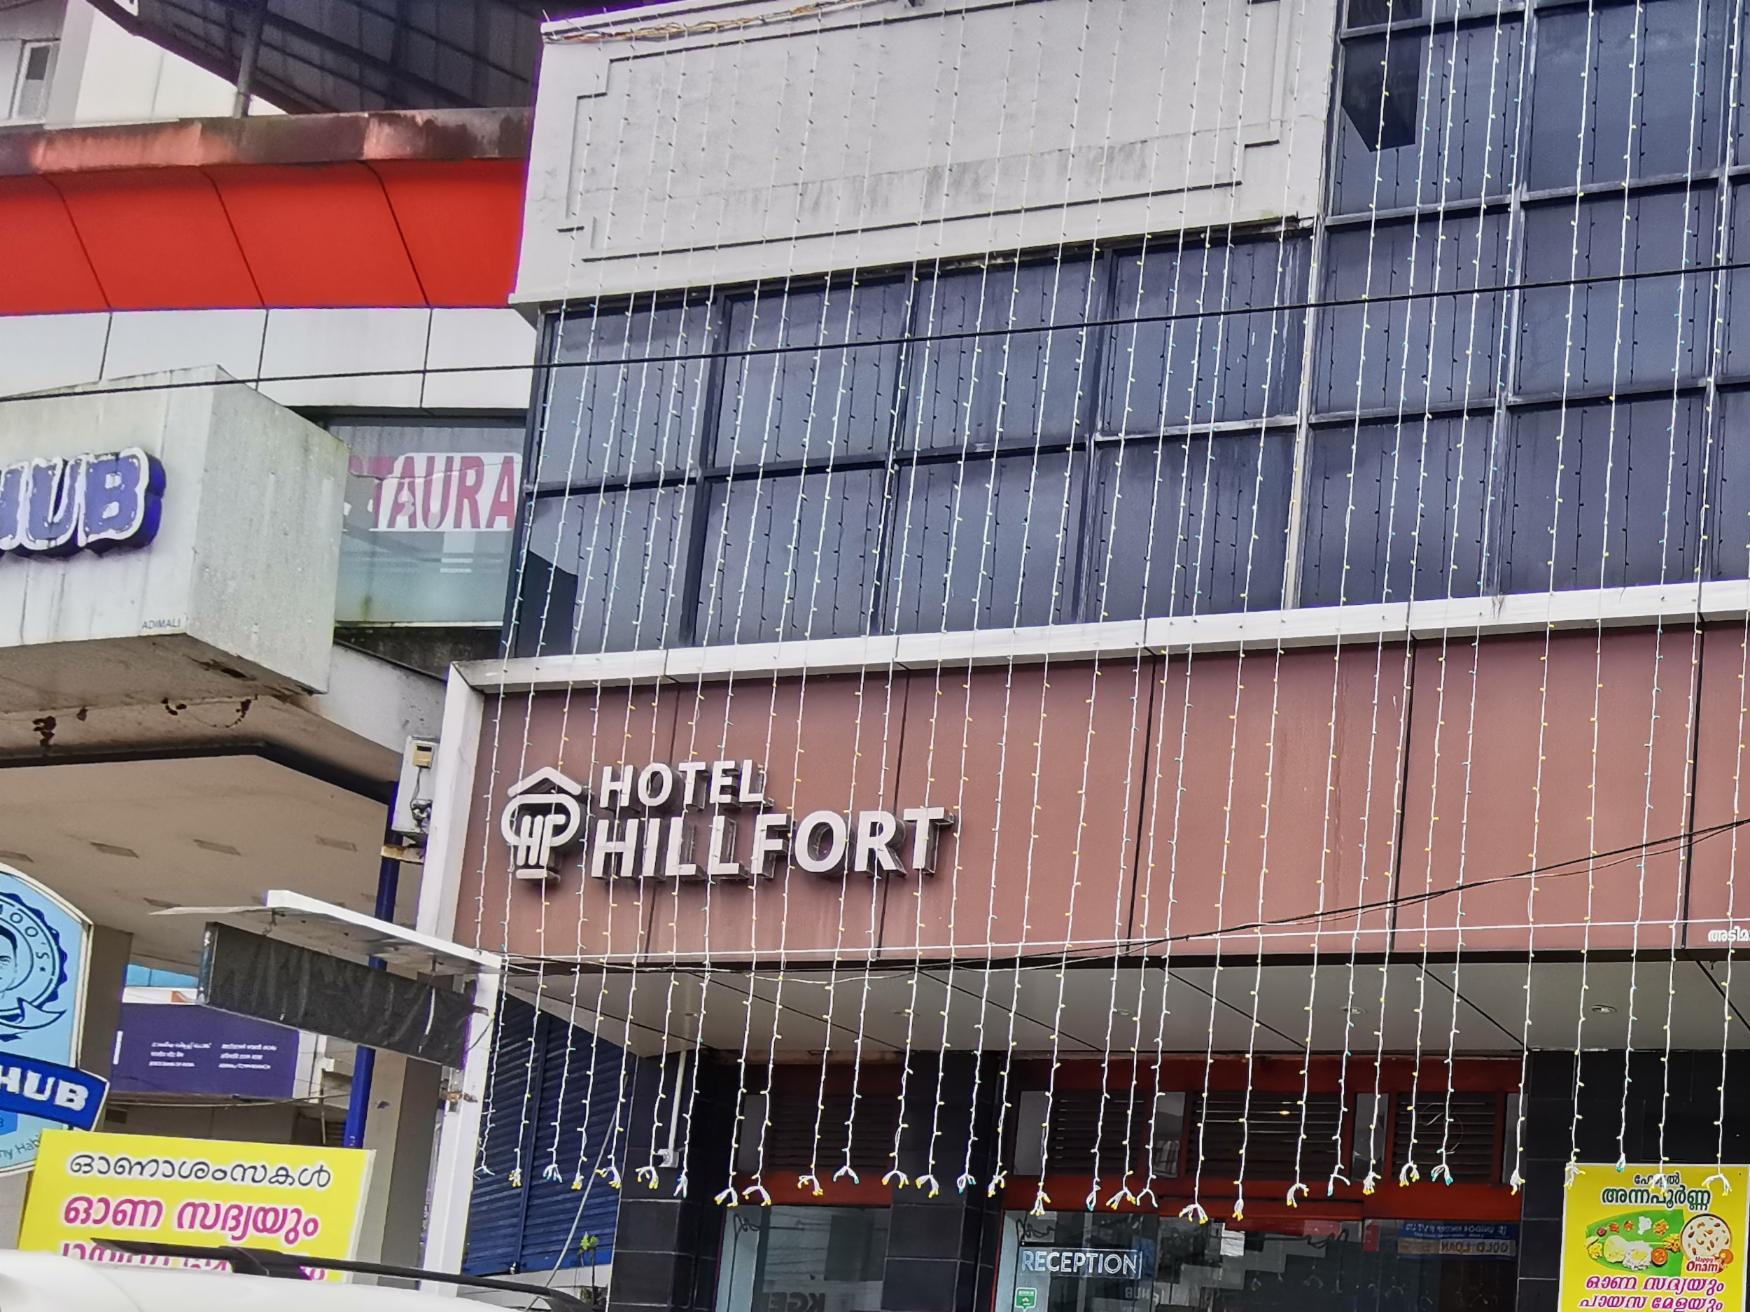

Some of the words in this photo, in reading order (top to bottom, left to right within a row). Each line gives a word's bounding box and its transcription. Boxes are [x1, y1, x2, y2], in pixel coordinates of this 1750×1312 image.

[600, 760, 770, 808] HOTEL
[592, 806, 956, 878] HILLFORT
[0, 1065, 89, 1111] HUB
[69, 1153, 332, 1188] ഓണാശംസകൾ
[63, 1195, 164, 1228] ഓണ
[176, 1200, 320, 1245] സദ്യയും
[1021, 1250, 1137, 1274] RECEPTION
[1686, 1260, 1718, 1272] Onam
[1579, 1295, 1648, 1309] പായസ
[1585, 1275, 1638, 1290] ഓണ
[1642, 1276, 1725, 1296] സദ്യയും
